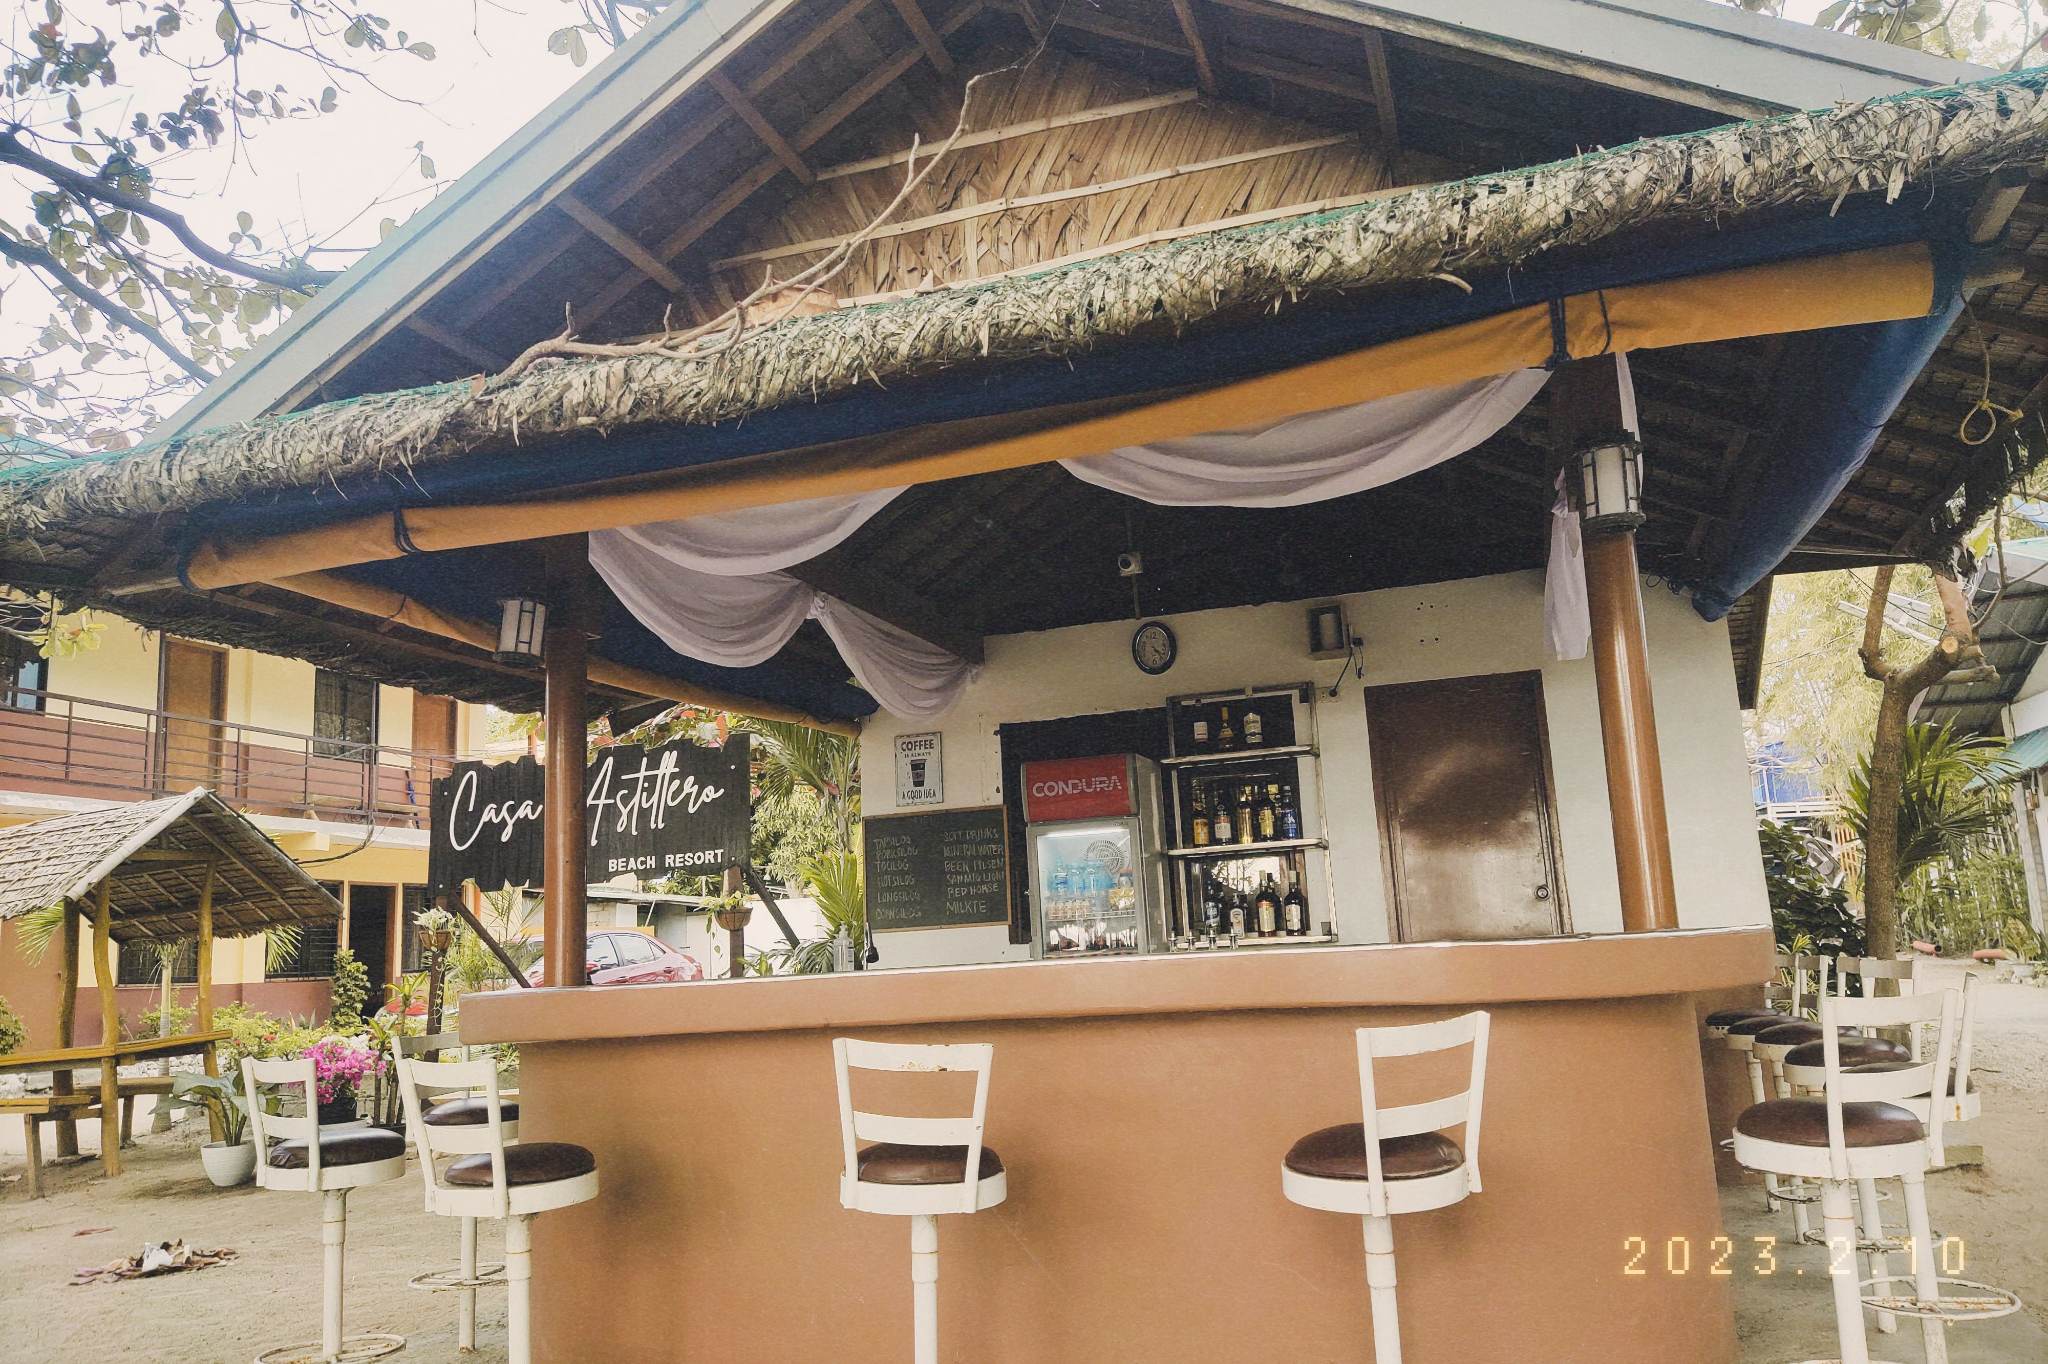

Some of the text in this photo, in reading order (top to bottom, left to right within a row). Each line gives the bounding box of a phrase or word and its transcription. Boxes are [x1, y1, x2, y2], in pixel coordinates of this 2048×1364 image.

[901, 739, 935, 752] COFFEE
[906, 789, 923, 801] GOOD
[923, 788, 937, 799] IDEA
[1032, 775, 1122, 798] CONDURA
[449, 750, 725, 851] Casa Astillero
[608, 849, 724, 872] BEACH RESORT
